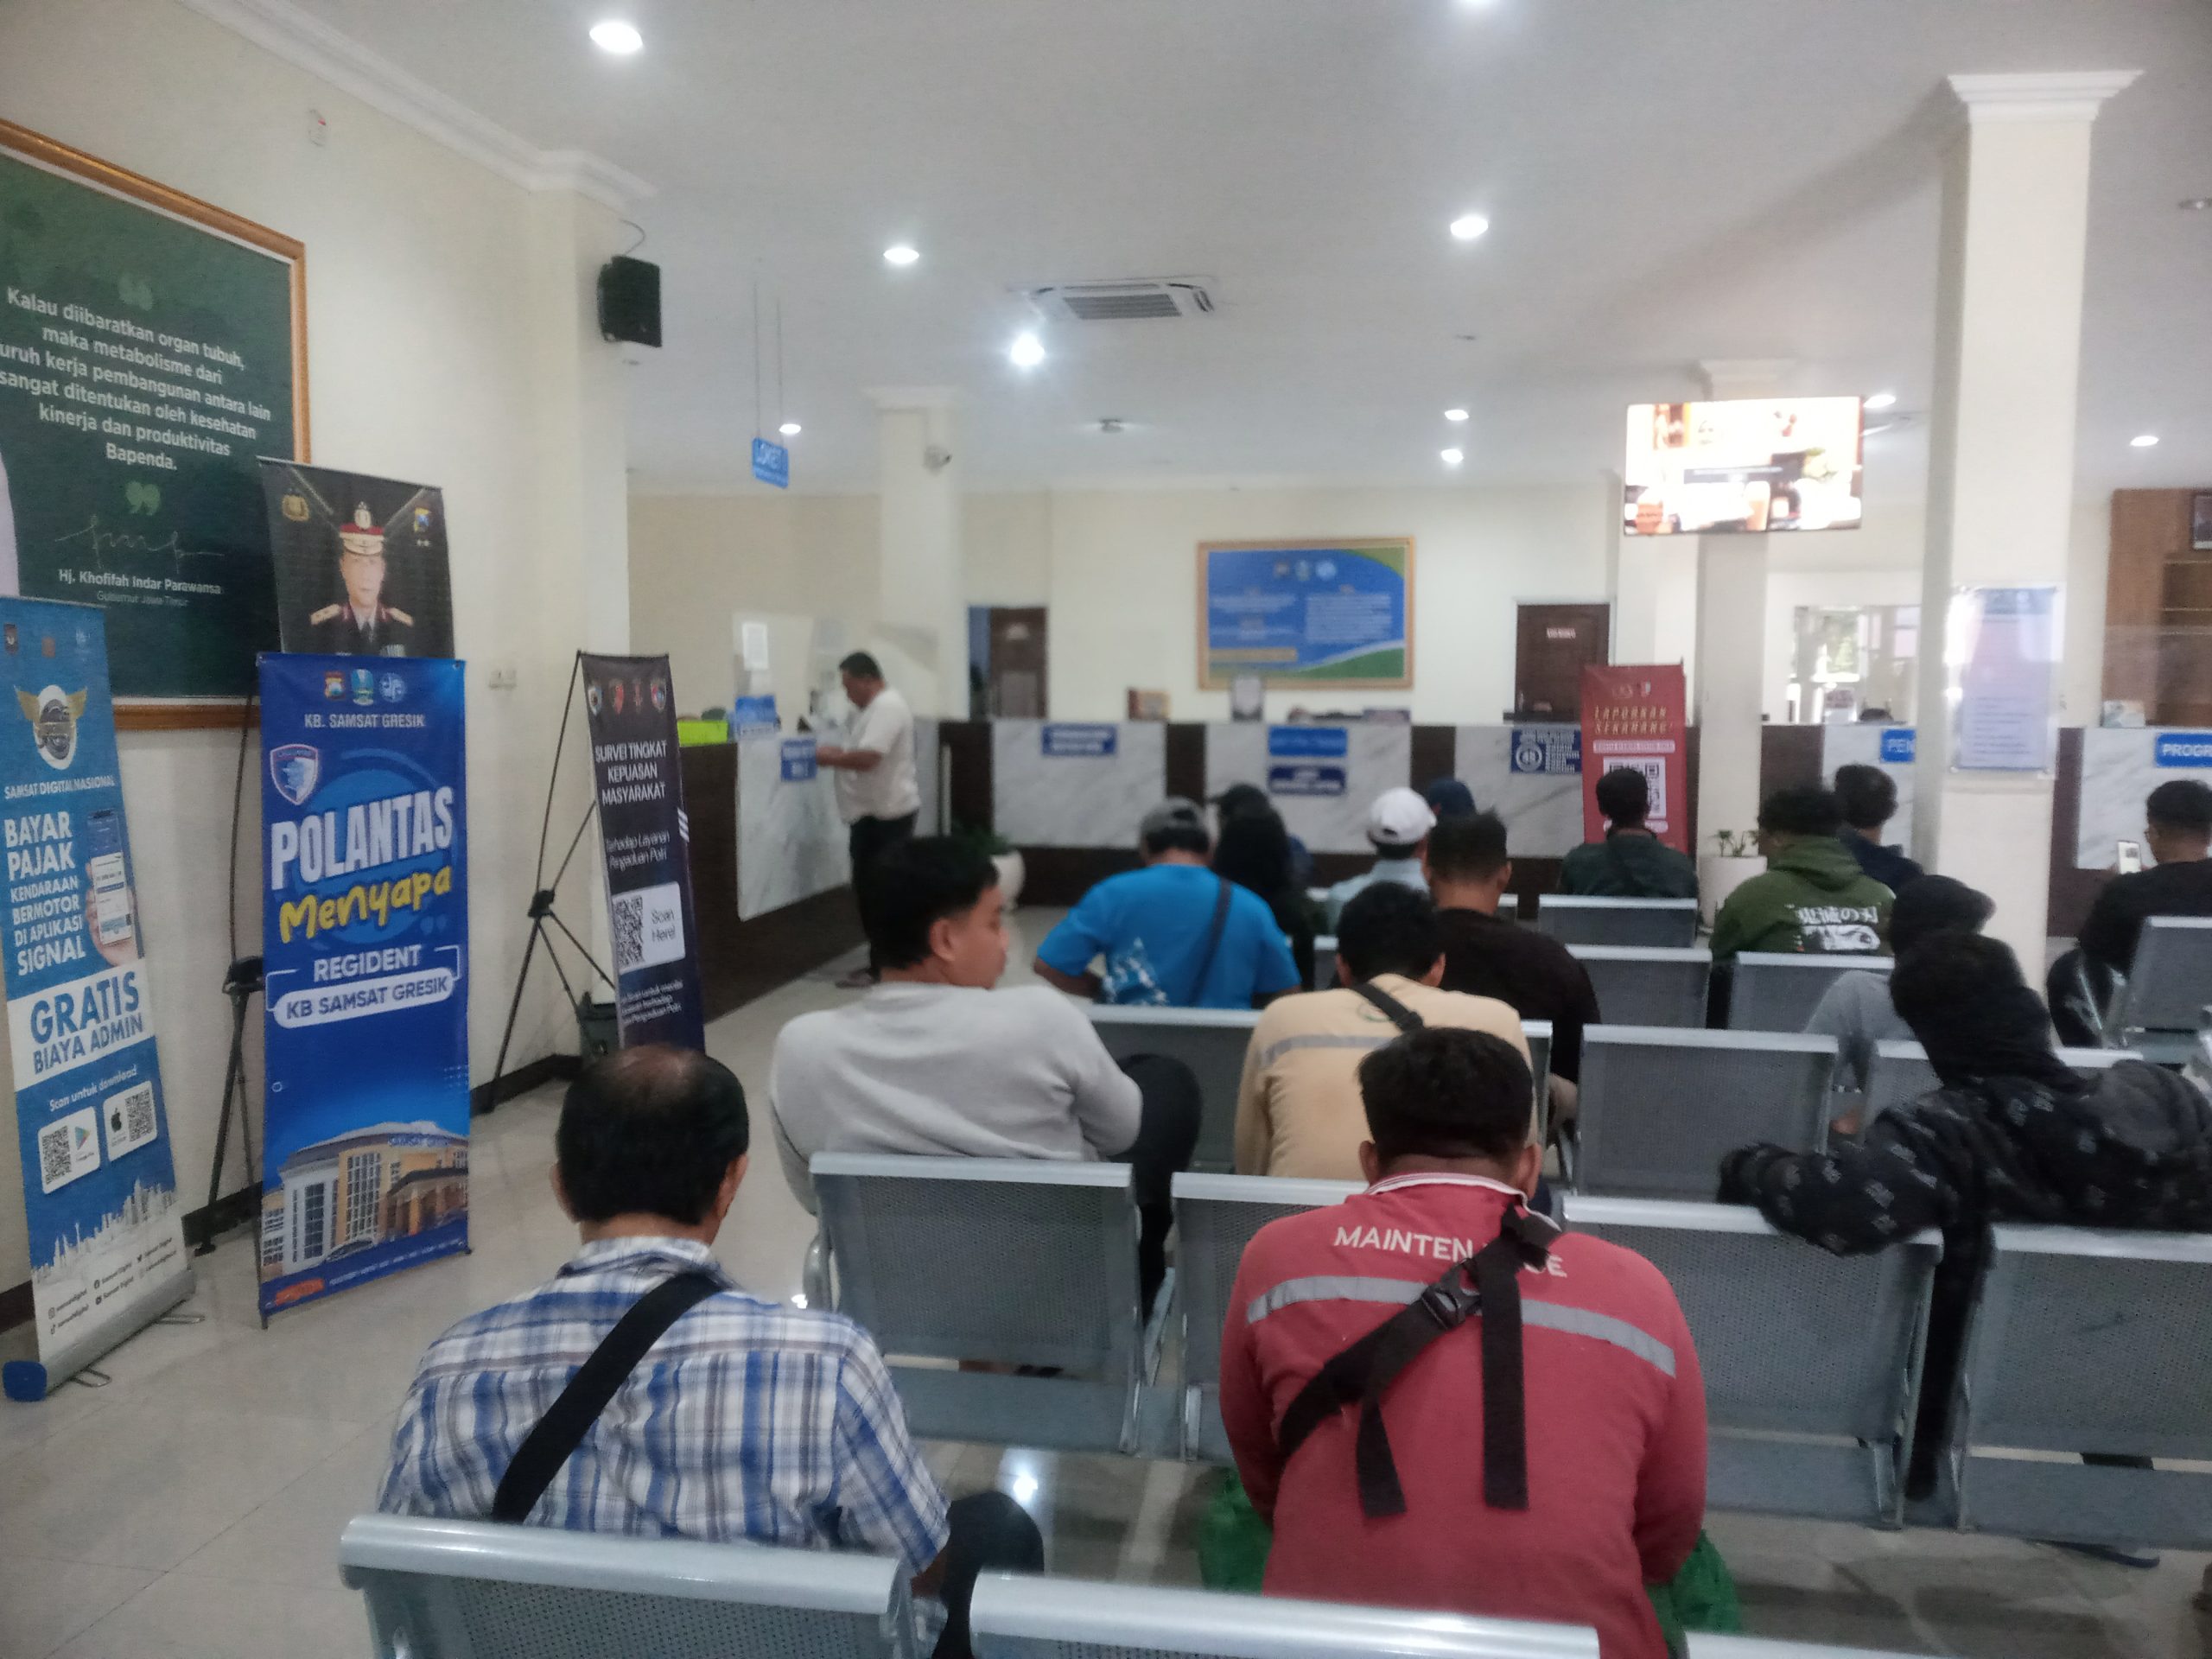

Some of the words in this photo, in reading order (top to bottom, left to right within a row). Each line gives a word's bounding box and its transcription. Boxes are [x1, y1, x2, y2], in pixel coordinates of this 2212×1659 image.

[8, 286, 57, 316] Kalau
[63, 303, 154, 343] diibaratkan
[159, 334, 200, 355] organ
[203, 343, 245, 371] tubuh,
[42, 327, 89, 352] maka
[93, 340, 192, 377] metabolisme
[195, 364, 223, 385] dari
[0, 371, 60, 396] sangat
[63, 382, 151, 416] ditentukan
[156, 404, 187, 423] oleh
[190, 410, 257, 440] kesehatan
[46, 350, 87, 378] kerja
[92, 366, 201, 403] pembangunan
[205, 392, 245, 415] antara
[248, 401, 271, 421] lain
[39, 403, 98, 432] kinerja
[102, 417, 131, 437] dan
[136, 424, 232, 456] produktivitas
[105, 442, 178, 471] Bapenda.
[59, 569, 76, 585] Hj.
[79, 570, 130, 588] Khofifah
[164, 578, 222, 595] Parawansa
[304, 714, 327, 728] KB.
[329, 714, 378, 728] SAMSAT
[382, 714, 426, 728] GRESIK
[594, 743, 627, 764] SURVEI
[629, 740, 667, 760] TINGKAT
[607, 761, 658, 784] KEPUASAN
[3, 782, 38, 800] SAMSAT
[40, 779, 72, 795] DIGITAL
[73, 775, 116, 791] NASIONAL
[601, 781, 666, 807] MASYARAKAT
[4, 810, 73, 849] BAYAR
[270, 785, 454, 891] POLANTAS
[7, 841, 76, 882] PAJAK
[10, 874, 79, 904] KENDARAAN
[12, 893, 79, 925] BERMOTOR
[279, 865, 452, 944] Menyapa
[14, 929, 28, 948] DI
[29, 913, 84, 941] APLIKASI
[651, 908, 674, 924] Scan
[17, 935, 86, 976] SIGNAL
[314, 944, 423, 982] REGIDENT
[30, 970, 140, 1045] GRATIS
[286, 1000, 314, 1020] KB
[319, 986, 387, 1015] SAMSAT
[392, 976, 448, 1001] GRESIK
[33, 1035, 86, 1075] BIAYA
[90, 1012, 143, 1053] ADMIN
[49, 1097, 70, 1113] Scan
[71, 1082, 98, 1102] untuk
[99, 1063, 137, 1091] download
[1333, 1225, 1567, 1279] MAINTENE
